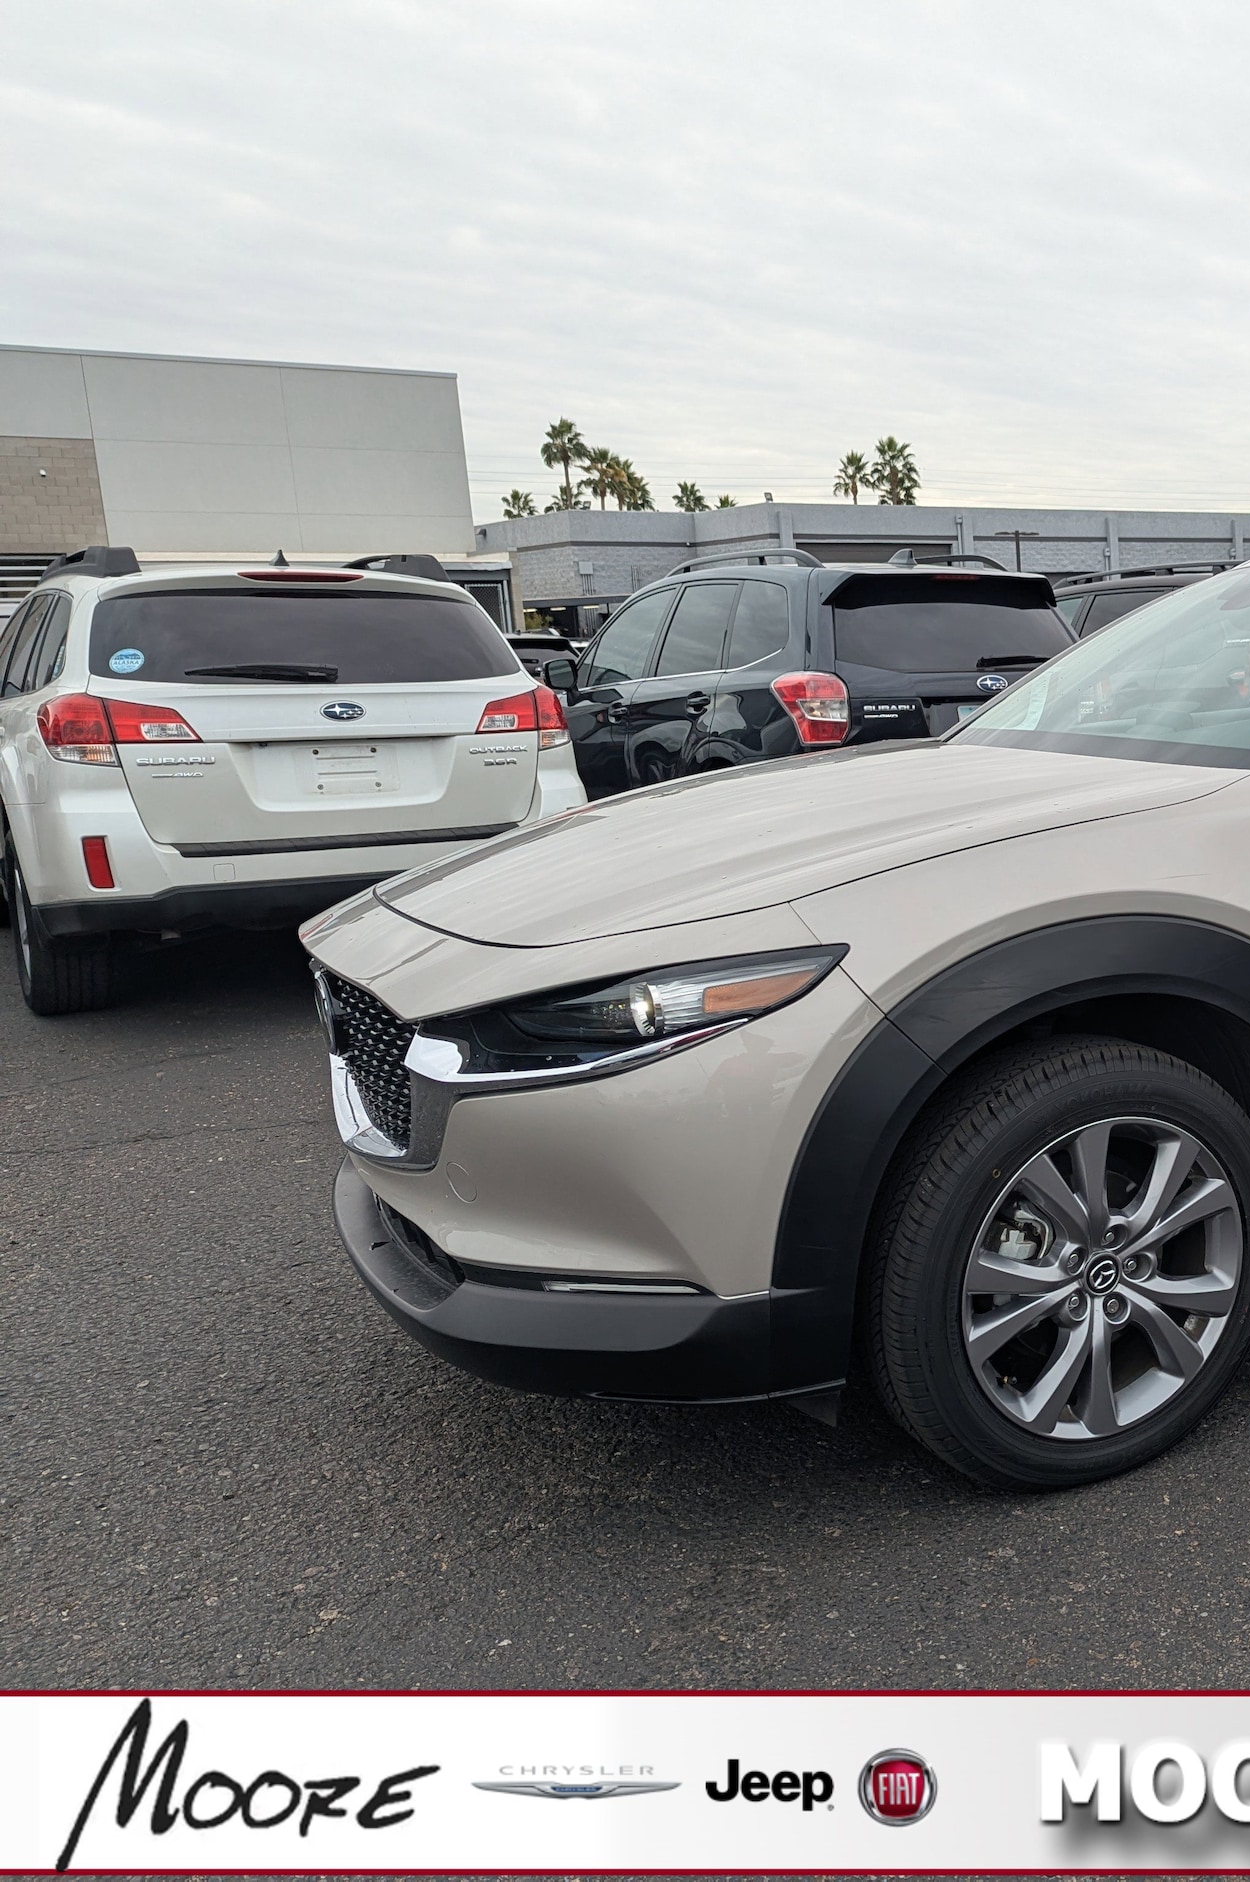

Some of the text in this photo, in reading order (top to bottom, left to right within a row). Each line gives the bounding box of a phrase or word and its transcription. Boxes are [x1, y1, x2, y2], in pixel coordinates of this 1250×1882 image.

[863, 704, 915, 712] SUBARU
[469, 745, 528, 754] OUTBACK
[136, 756, 216, 766] SUBARU
